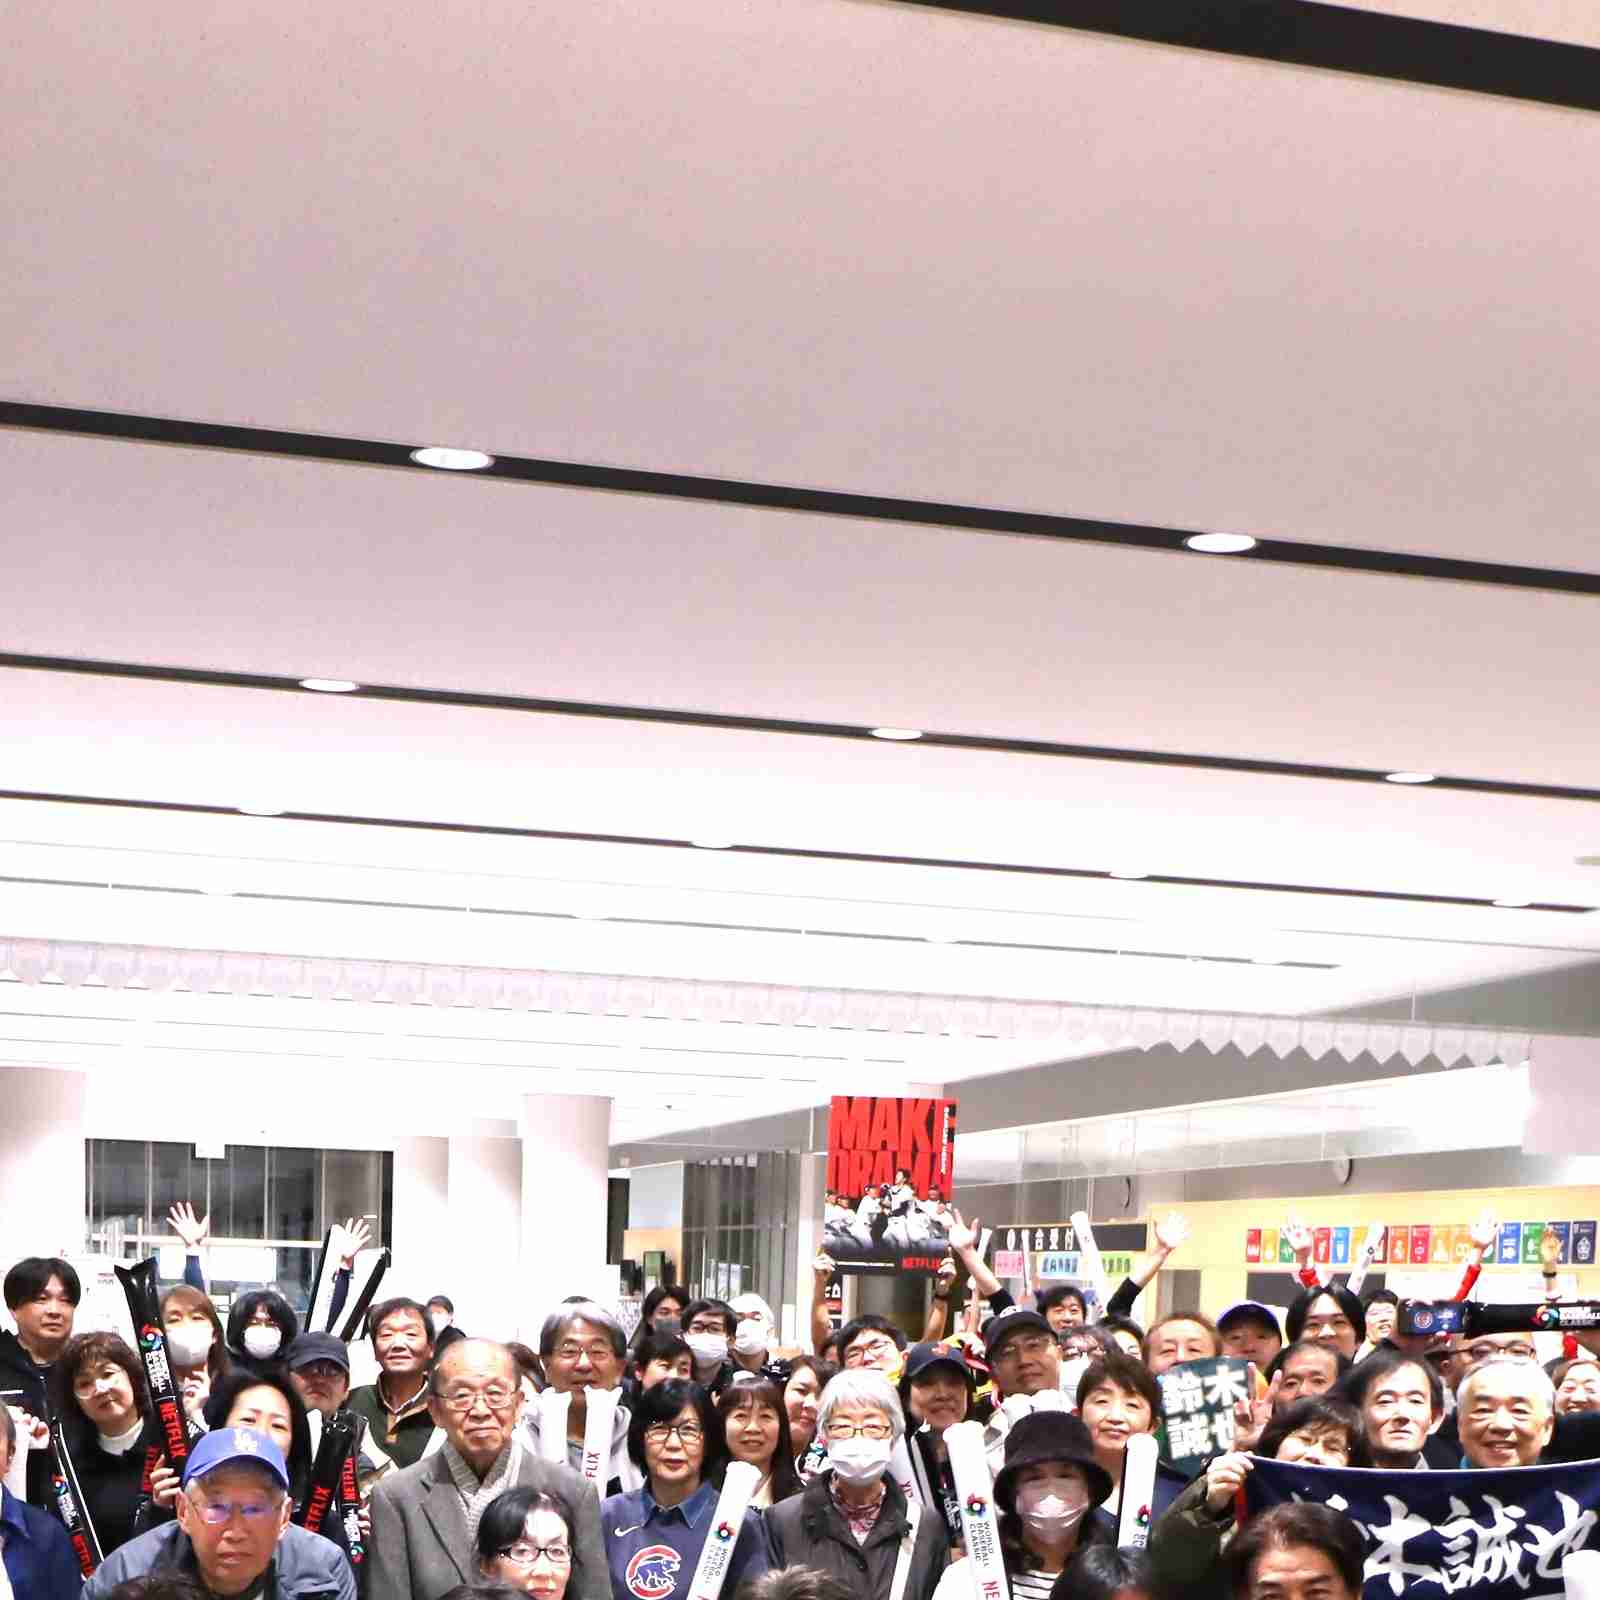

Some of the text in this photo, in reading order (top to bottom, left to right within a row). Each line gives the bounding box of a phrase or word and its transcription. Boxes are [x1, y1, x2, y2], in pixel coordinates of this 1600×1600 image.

[829, 1096, 958, 1151] MAKE
[160, 1402, 187, 1457] NETFLIX
[586, 1451, 601, 1480] FLIX
[1345, 1490, 1599, 1596] 木誠也
